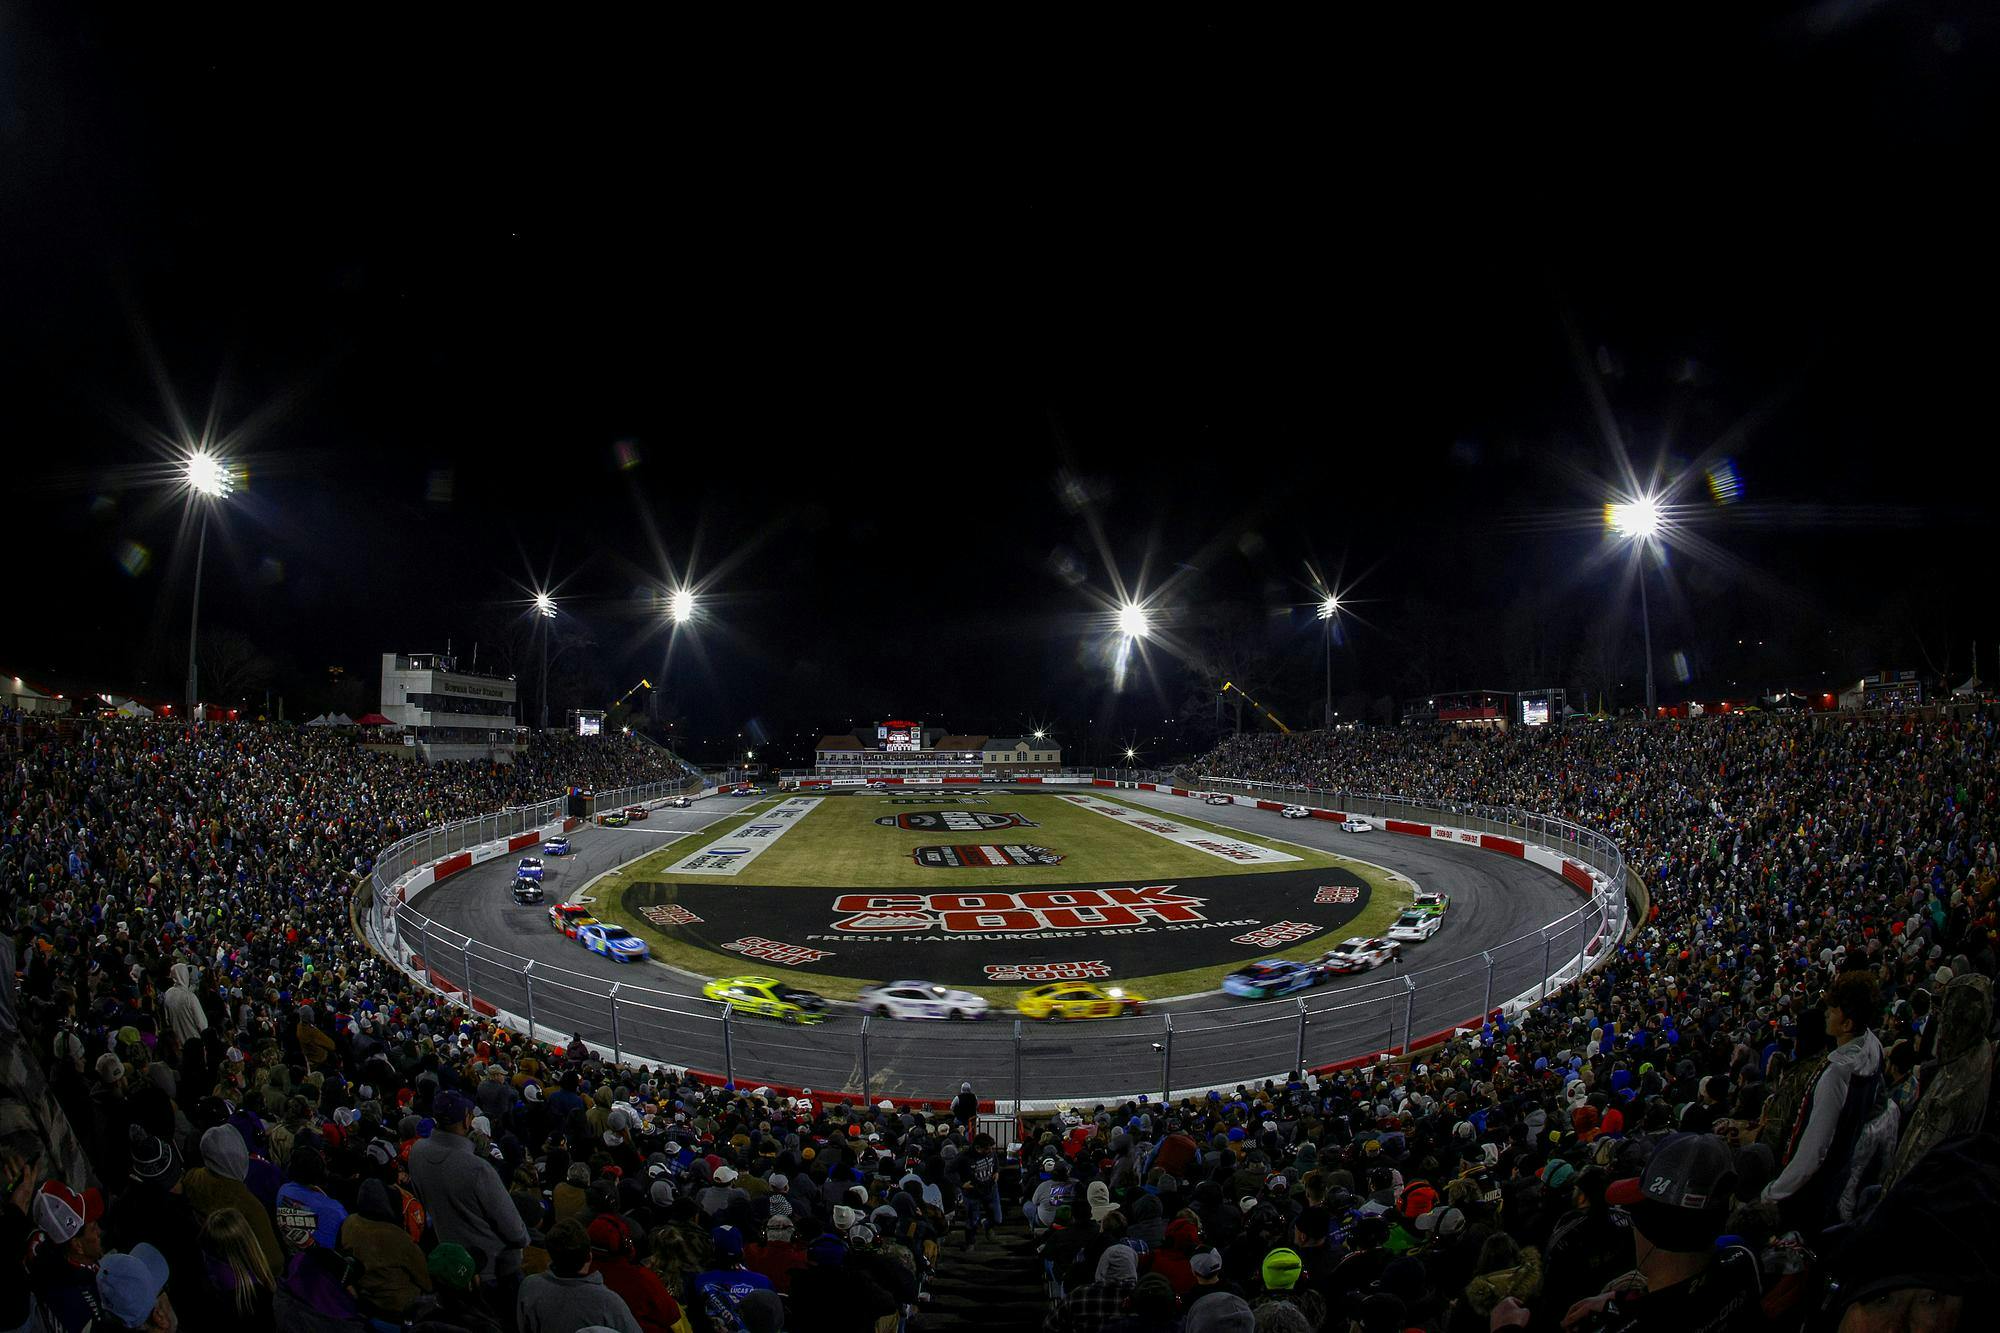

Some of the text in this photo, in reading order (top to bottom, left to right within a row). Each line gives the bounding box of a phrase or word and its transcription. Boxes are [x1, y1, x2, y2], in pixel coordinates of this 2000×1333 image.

[833, 886, 1209, 913] COOK
[942, 903, 1208, 932] OUT
[806, 917, 1262, 943] FRESH HAMBURGERS BBQ SHAKES
[736, 936, 836, 960] COOK
[984, 960, 1112, 973] COOK
[1022, 967, 1112, 981] OUT
[1649, 1176, 1672, 1195] 24
